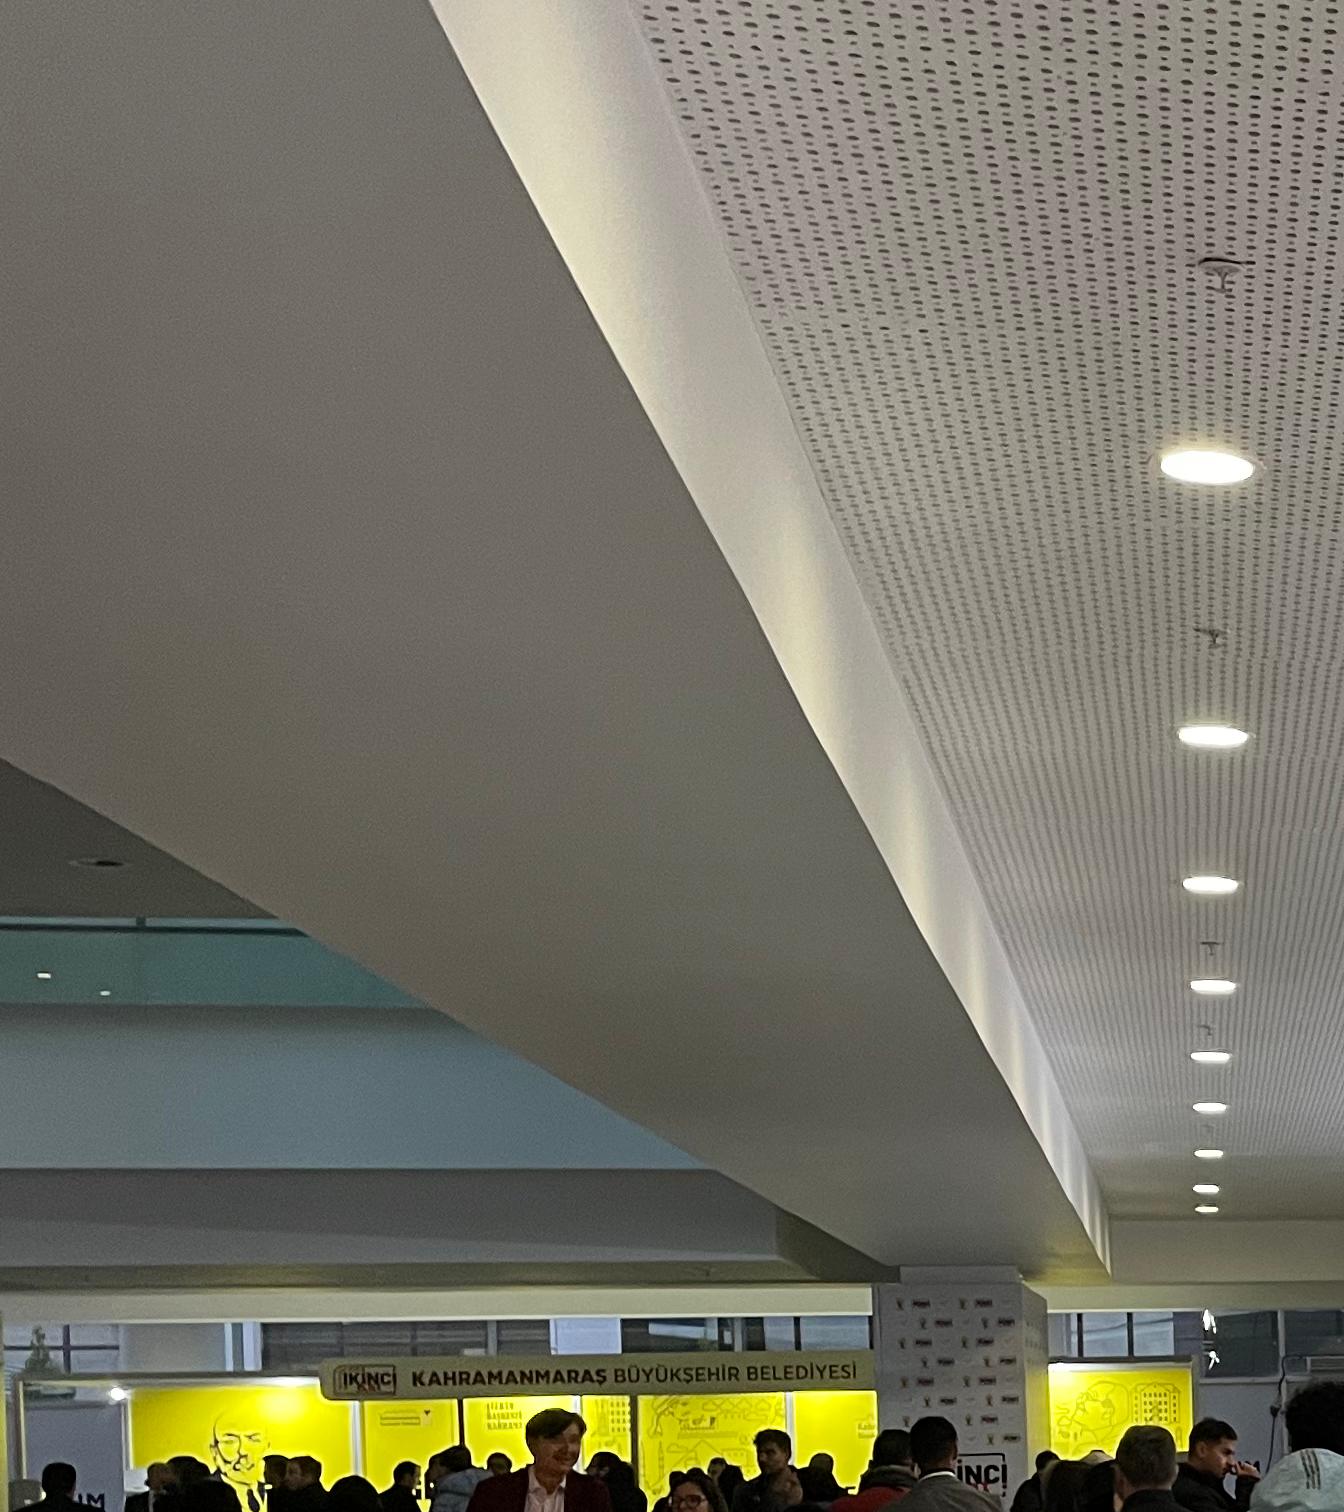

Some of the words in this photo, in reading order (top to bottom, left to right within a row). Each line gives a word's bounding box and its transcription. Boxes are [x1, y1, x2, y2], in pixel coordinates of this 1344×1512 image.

[411, 1368, 607, 1388] KAHRAMANMARAŞ
[613, 1363, 740, 1385] BÜYÜKŞEHİR
[746, 1360, 858, 1381] BELEDİYESİ
